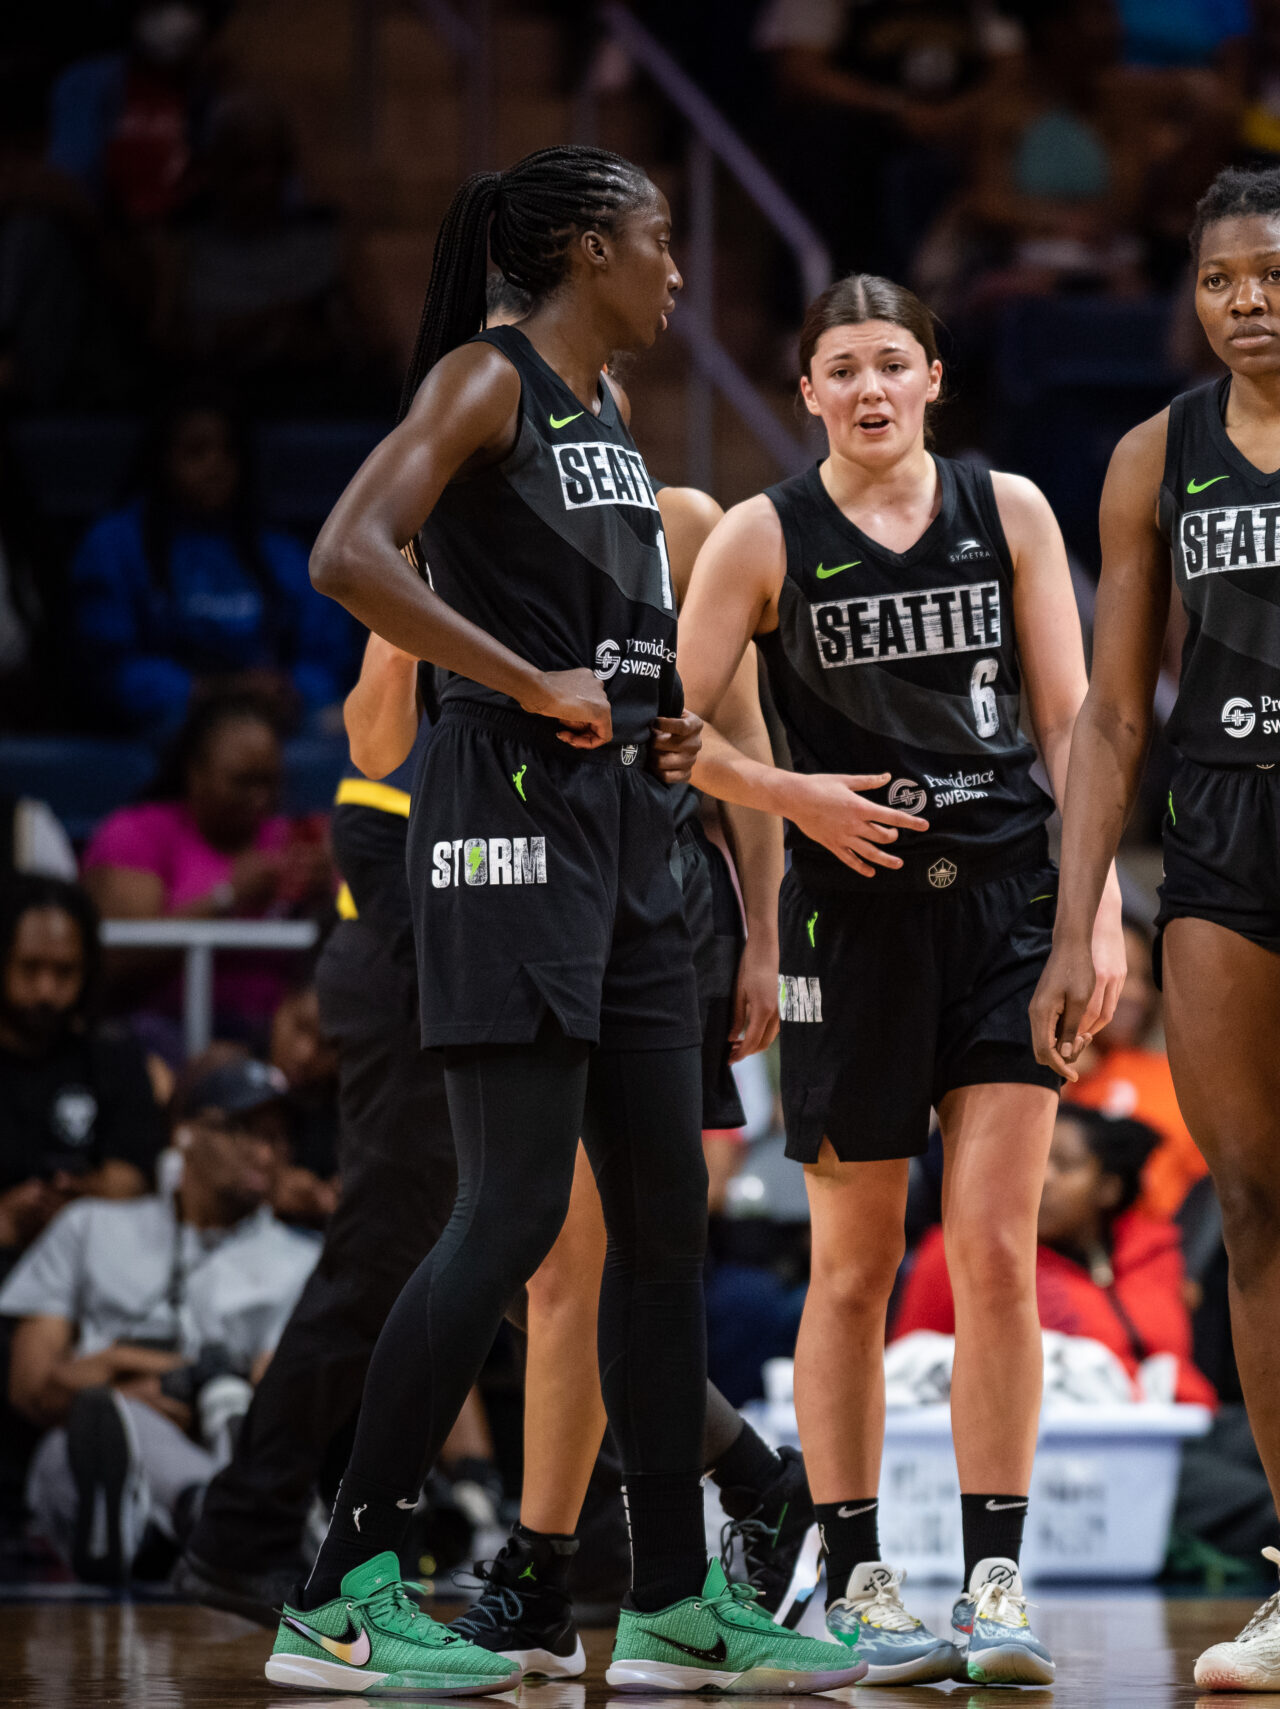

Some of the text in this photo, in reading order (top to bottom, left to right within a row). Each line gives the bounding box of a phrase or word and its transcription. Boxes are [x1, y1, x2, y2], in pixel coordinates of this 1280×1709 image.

[558, 446, 656, 506] SEATT
[950, 550, 992, 562] SYMETRA
[815, 586, 999, 663] SEATTLE
[620, 659, 661, 679] SWEDIS
[970, 657, 1000, 739] 6
[431, 836, 548, 889] STORM
